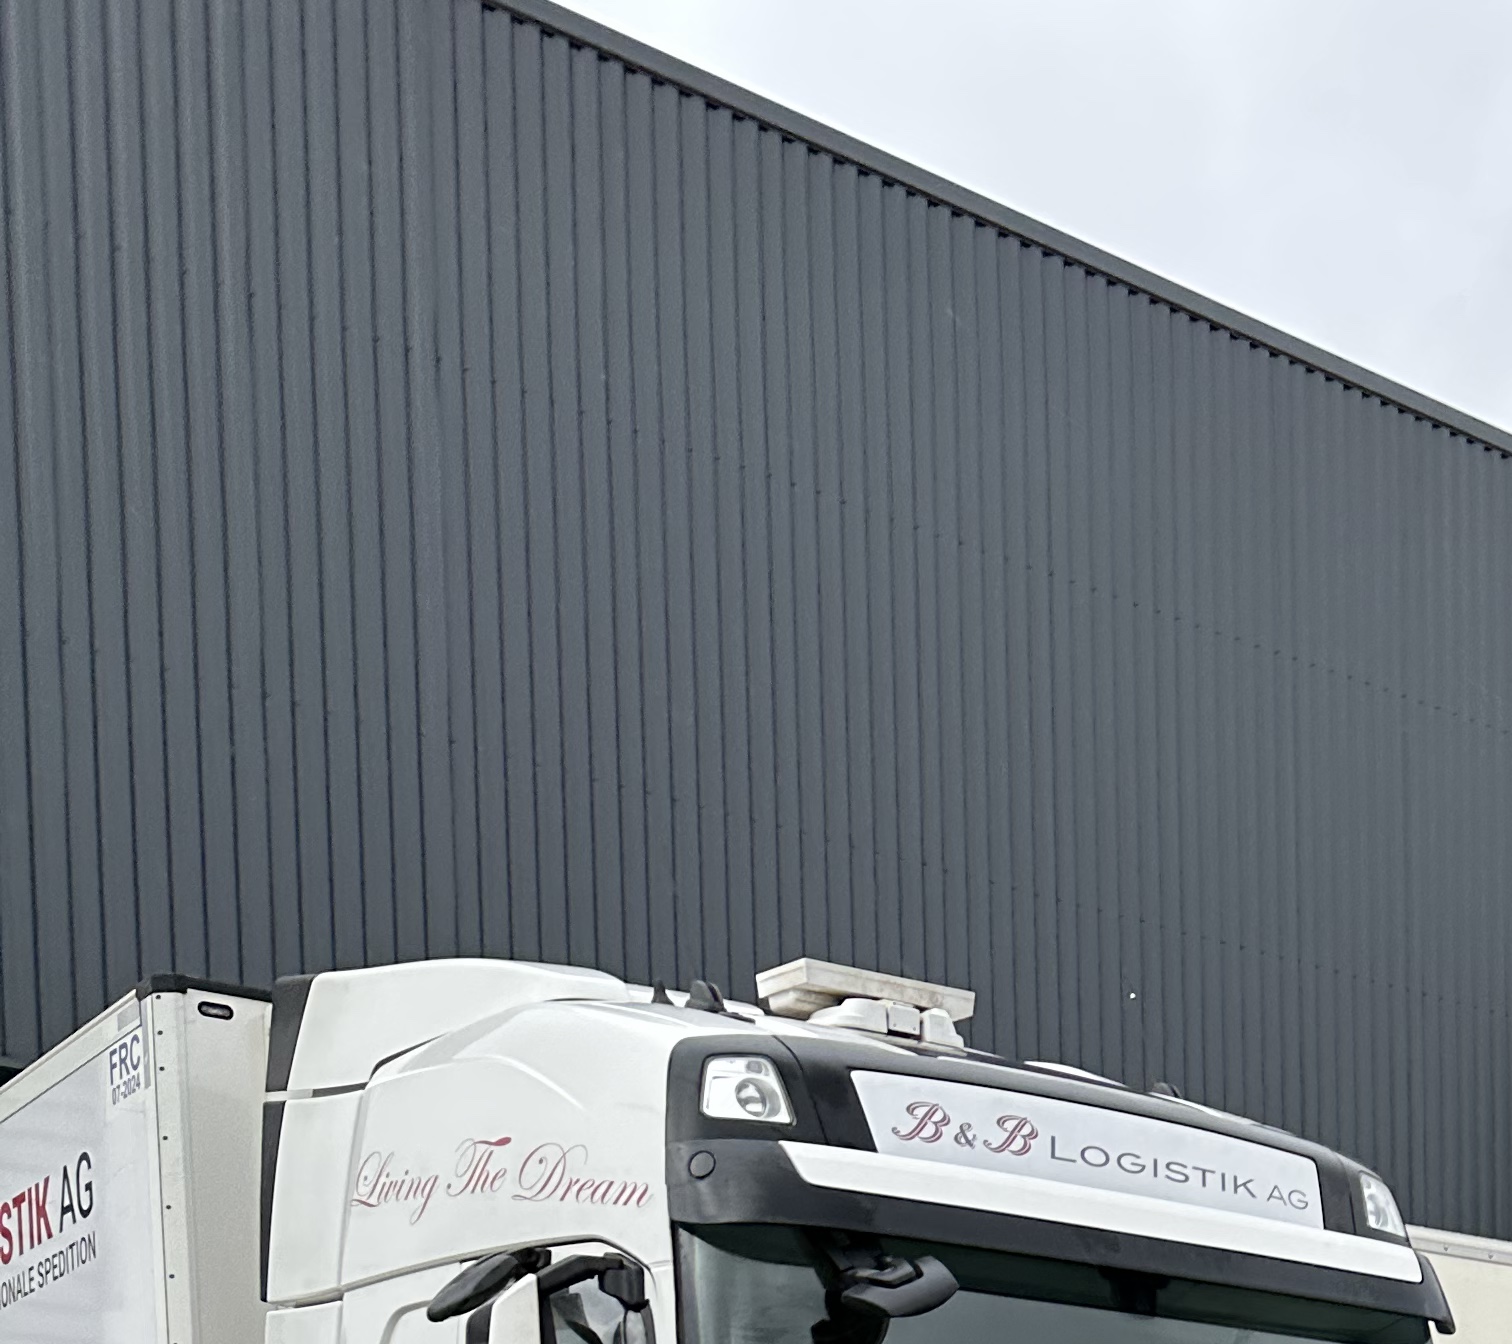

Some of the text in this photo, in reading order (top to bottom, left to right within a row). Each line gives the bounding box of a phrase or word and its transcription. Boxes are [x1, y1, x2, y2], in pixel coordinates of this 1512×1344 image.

[110, 1034, 140, 1086] FRC
[59, 1152, 93, 1234] AG
[351, 1136, 653, 1225] Living The Dream
[1051, 1136, 1258, 1199] LOGISTIK
[1267, 1185, 1309, 1210] AG
[0, 1231, 96, 1311] ONALE SPEDITION
